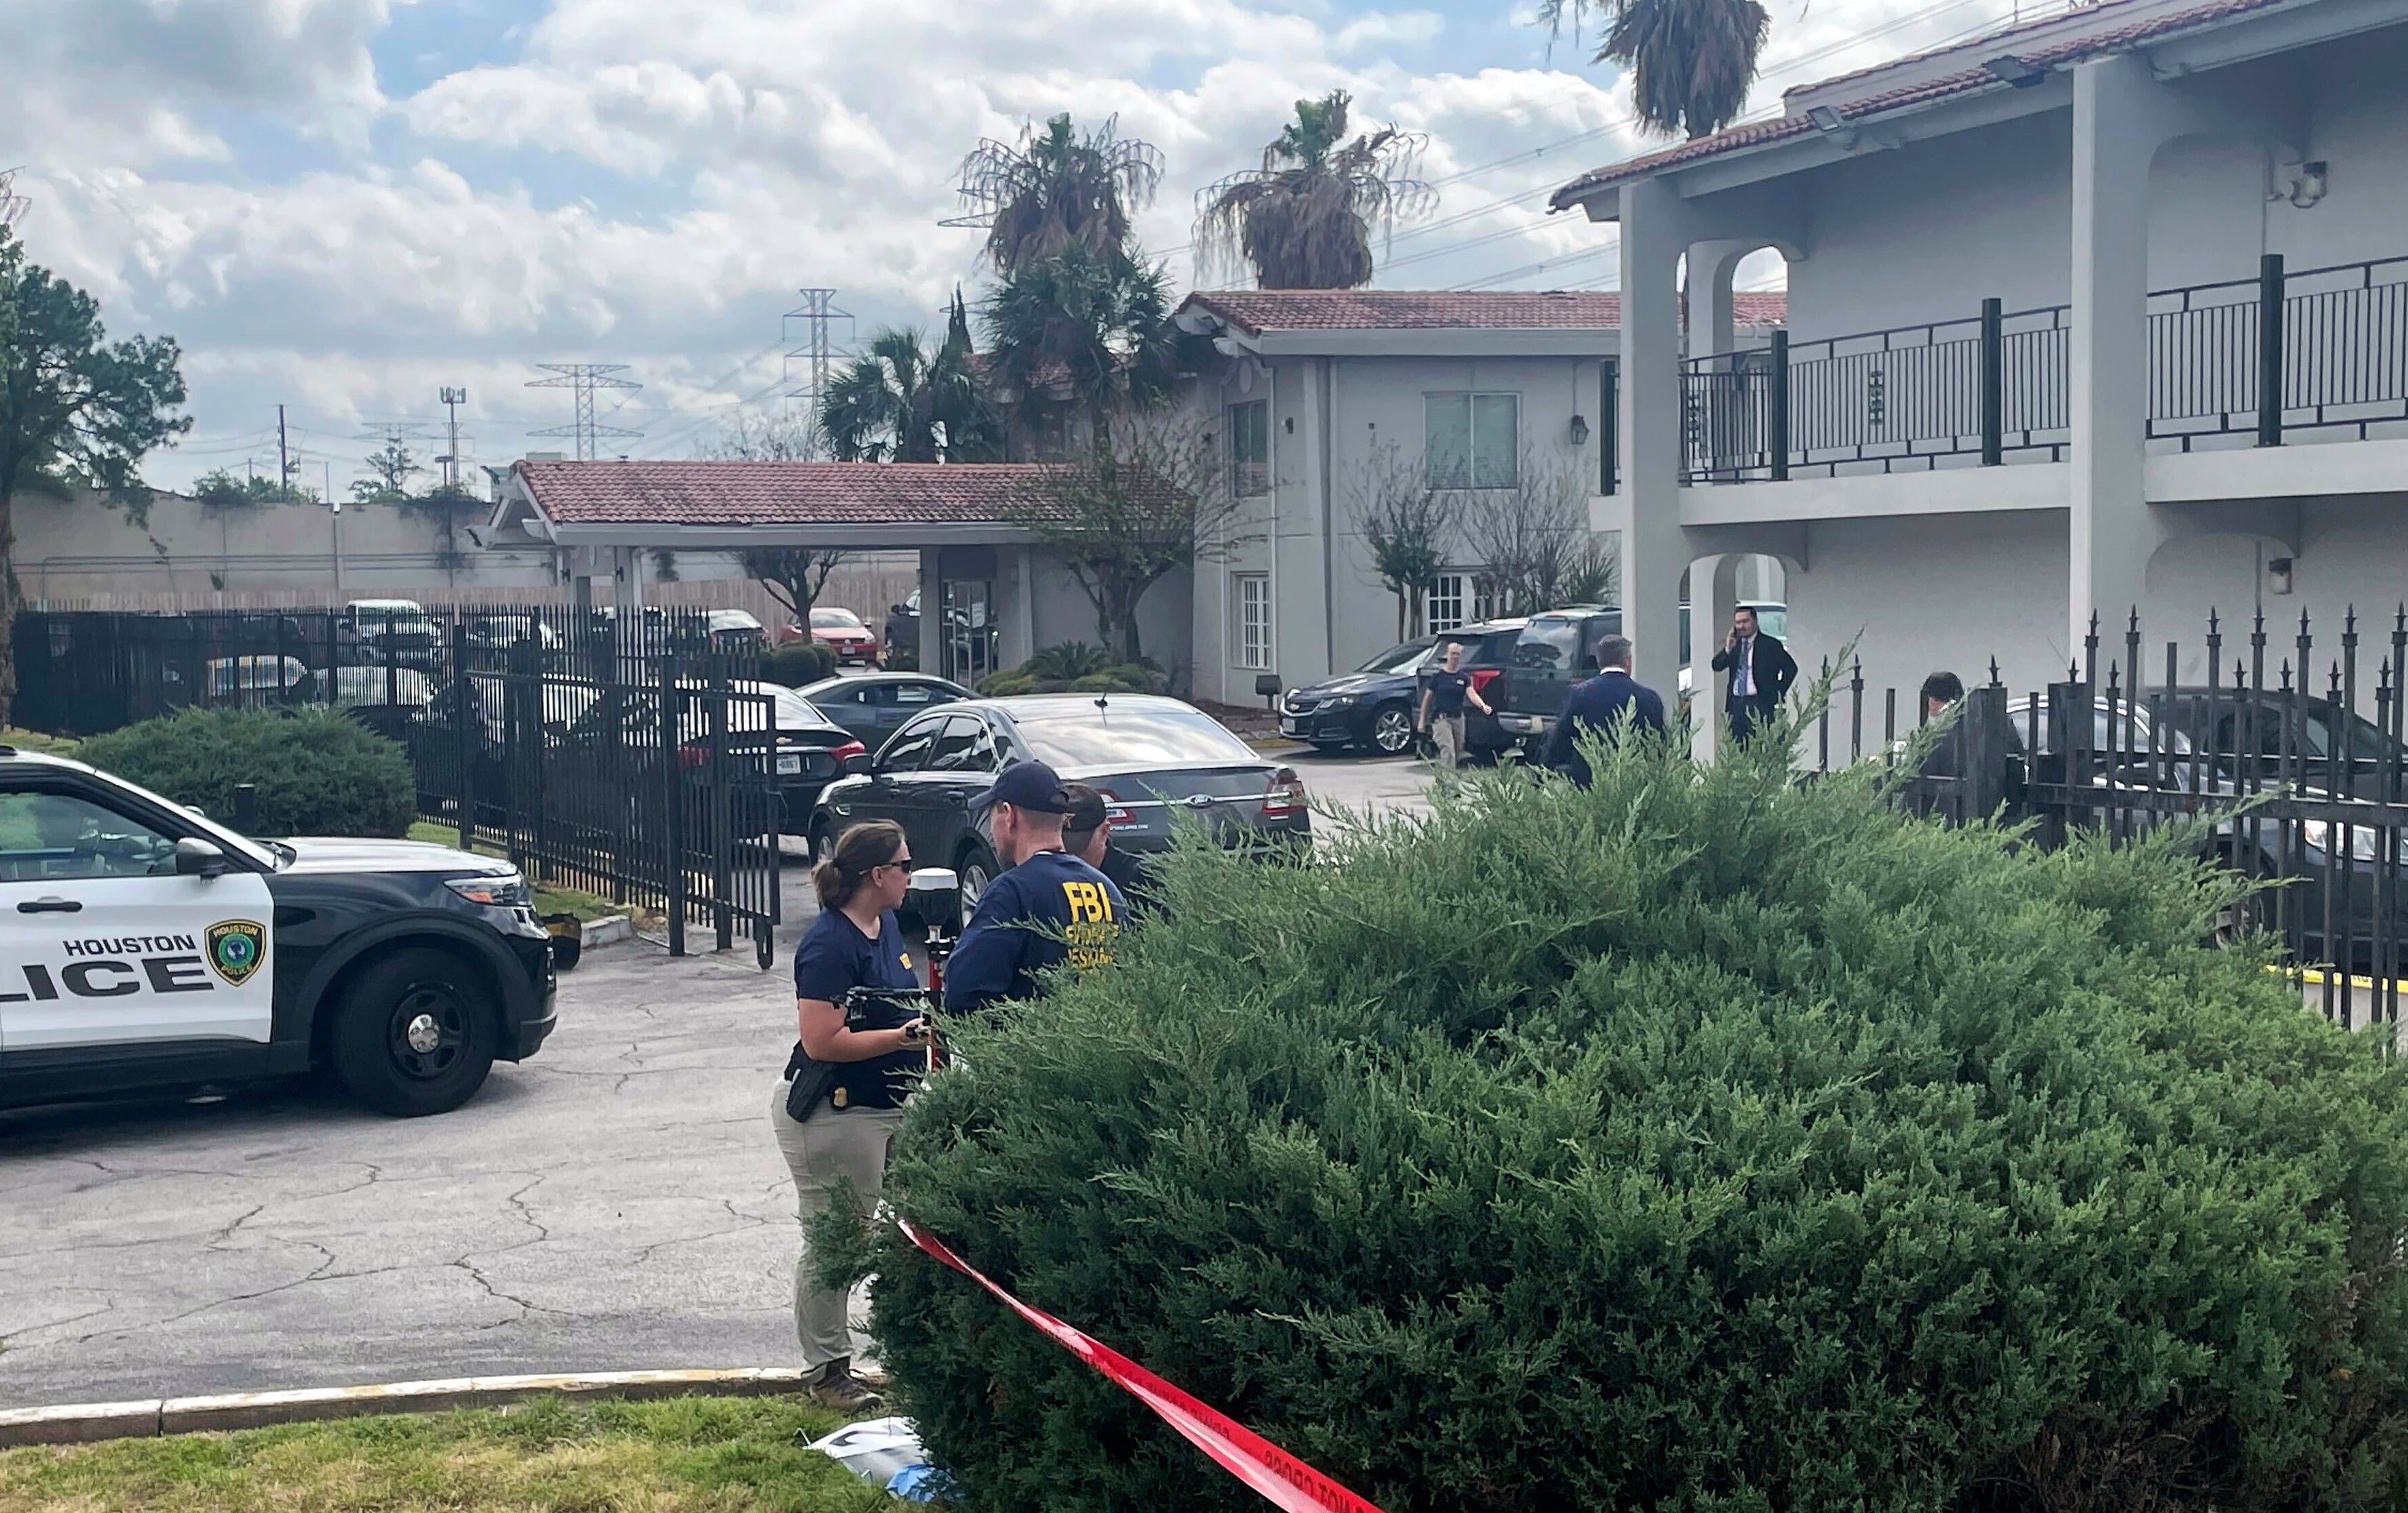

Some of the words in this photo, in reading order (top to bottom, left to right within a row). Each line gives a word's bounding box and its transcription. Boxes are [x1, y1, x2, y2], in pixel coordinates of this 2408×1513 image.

[1062, 882, 1113, 922] FBI
[213, 925, 259, 938] HOUSTON
[63, 934, 197, 956] HOUSTON
